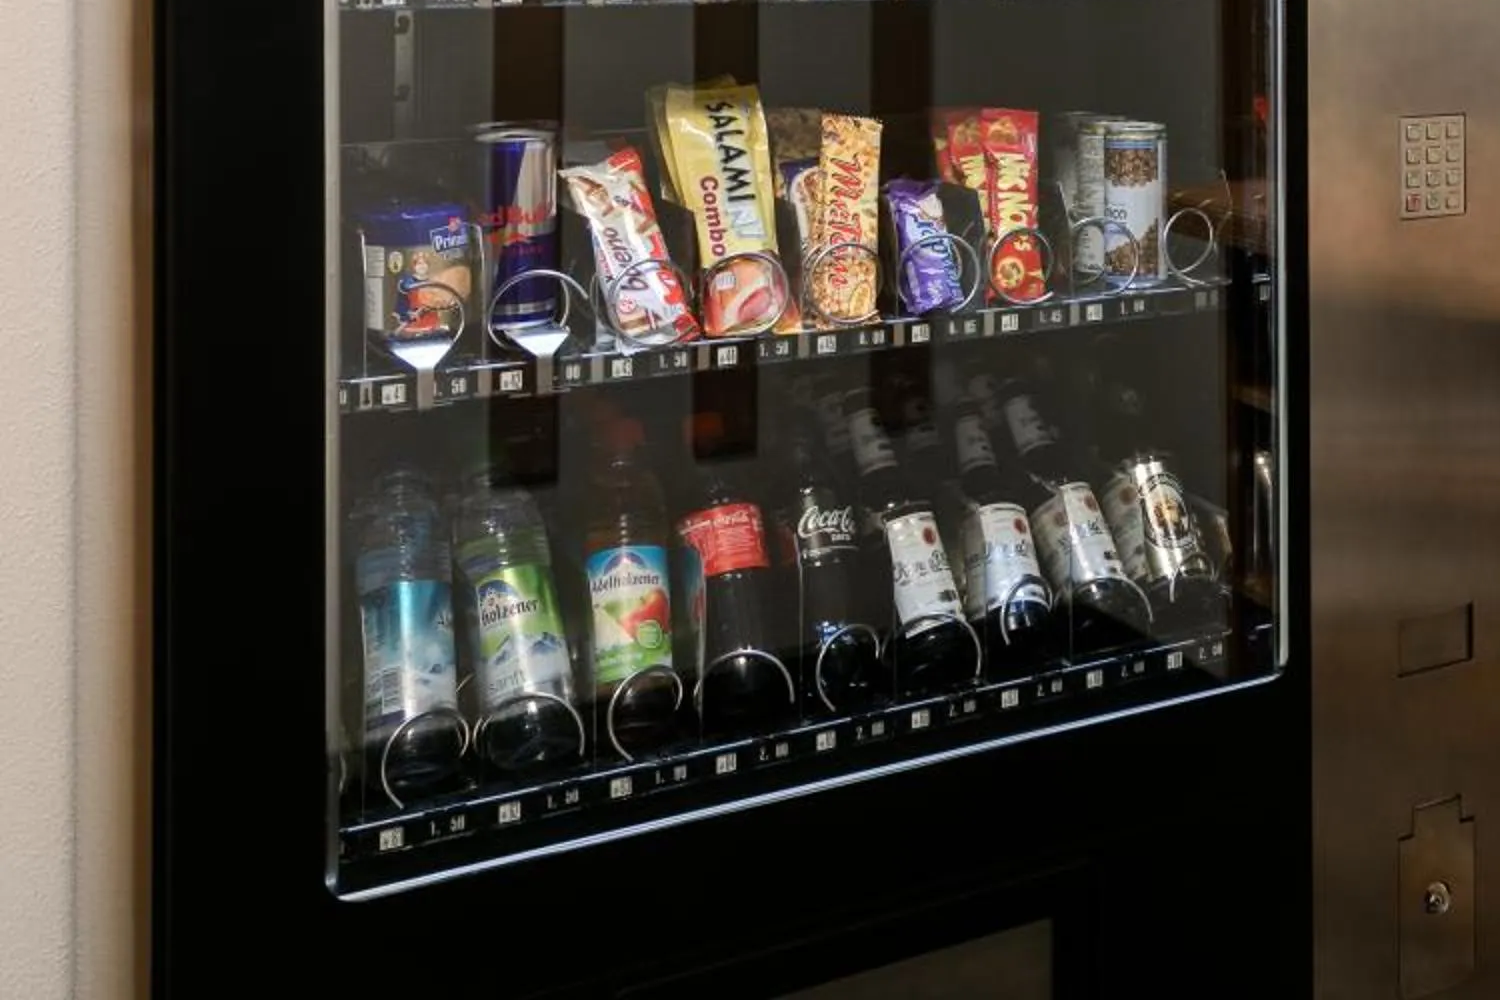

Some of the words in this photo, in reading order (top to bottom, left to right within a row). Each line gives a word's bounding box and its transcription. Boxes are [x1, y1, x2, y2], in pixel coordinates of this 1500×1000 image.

[699, 176, 728, 257] Combo
[603, 226, 649, 291] bueno
[553, 363, 581, 380] .00
